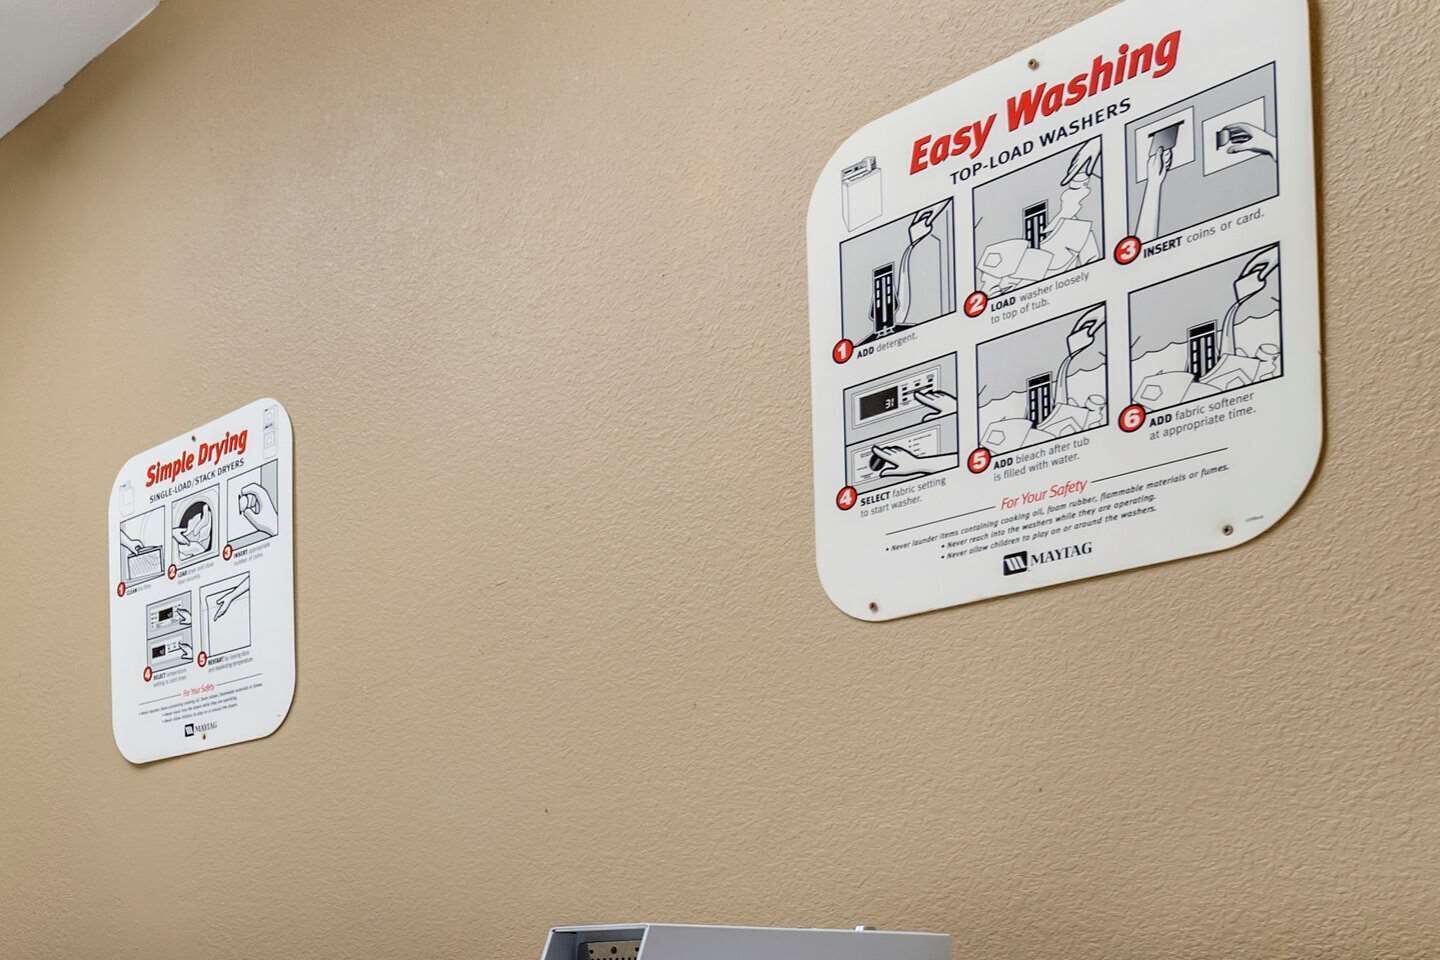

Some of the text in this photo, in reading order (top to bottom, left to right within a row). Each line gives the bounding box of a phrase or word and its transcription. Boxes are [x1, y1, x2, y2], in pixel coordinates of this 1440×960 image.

[910, 30, 1181, 175] Easy Washing
[949, 98, 1131, 185] TOP-LOAD WASHERS
[1144, 236, 1182, 258] INSERT
[1186, 227, 1216, 243] coins
[1220, 221, 1232, 231] or
[1236, 209, 1265, 226] card.
[991, 297, 1016, 312] LOAD
[1020, 285, 1053, 301] washer
[1055, 271, 1089, 290] loosely
[991, 299, 1050, 324] to top of tub.
[857, 346, 875, 359] ADD
[876, 332, 918, 352] detergent.
[1124, 391, 1255, 427] 6 ADD fabric softener
[1150, 405, 1256, 440] at appropriate time.
[145, 429, 248, 487] Simple Drying
[993, 457, 1013, 470] ADD
[1015, 450, 1046, 464] bleach
[1048, 443, 1071, 455] after
[1073, 437, 1090, 448] tub
[993, 452, 1080, 481] is filled with water.
[149, 457, 245, 503] SINGLE-LOAD/STACK DRYERS
[860, 491, 891, 507] SELECT
[892, 486, 915, 498] fabric
[917, 477, 946, 492] setting
[1000, 479, 1088, 511] For Your Safety
[860, 495, 923, 518] to start washer.
[890, 541, 911, 551] Never
[912, 535, 938, 546] launder
[939, 530, 959, 540] items
[960, 520, 999, 535] containing
[1000, 512, 1030, 526] cooking
[1046, 503, 1066, 514] foam
[1068, 496, 1098, 509] rubber,
[1099, 484, 1144, 502] flammable
[1146, 474, 1186, 489] materials
[1188, 472, 1198, 480] or
[1200, 463, 1230, 478] fumes.
[947, 493, 1157, 549] Never reach into the washers while they are operating.
[946, 549, 968, 559] Never
[969, 544, 988, 554] allow
[990, 537, 1020, 550] children
[1022, 533, 1031, 541] to
[1031, 529, 1050, 541] play
[1050, 527, 1061, 535] on
[1074, 517, 1102, 530] around
[1104, 513, 1118, 523] the
[1121, 505, 1157, 519] washers.
[1030, 541, 1093, 566] MAYTAG
[194, 721, 218, 733] MAYTAG
